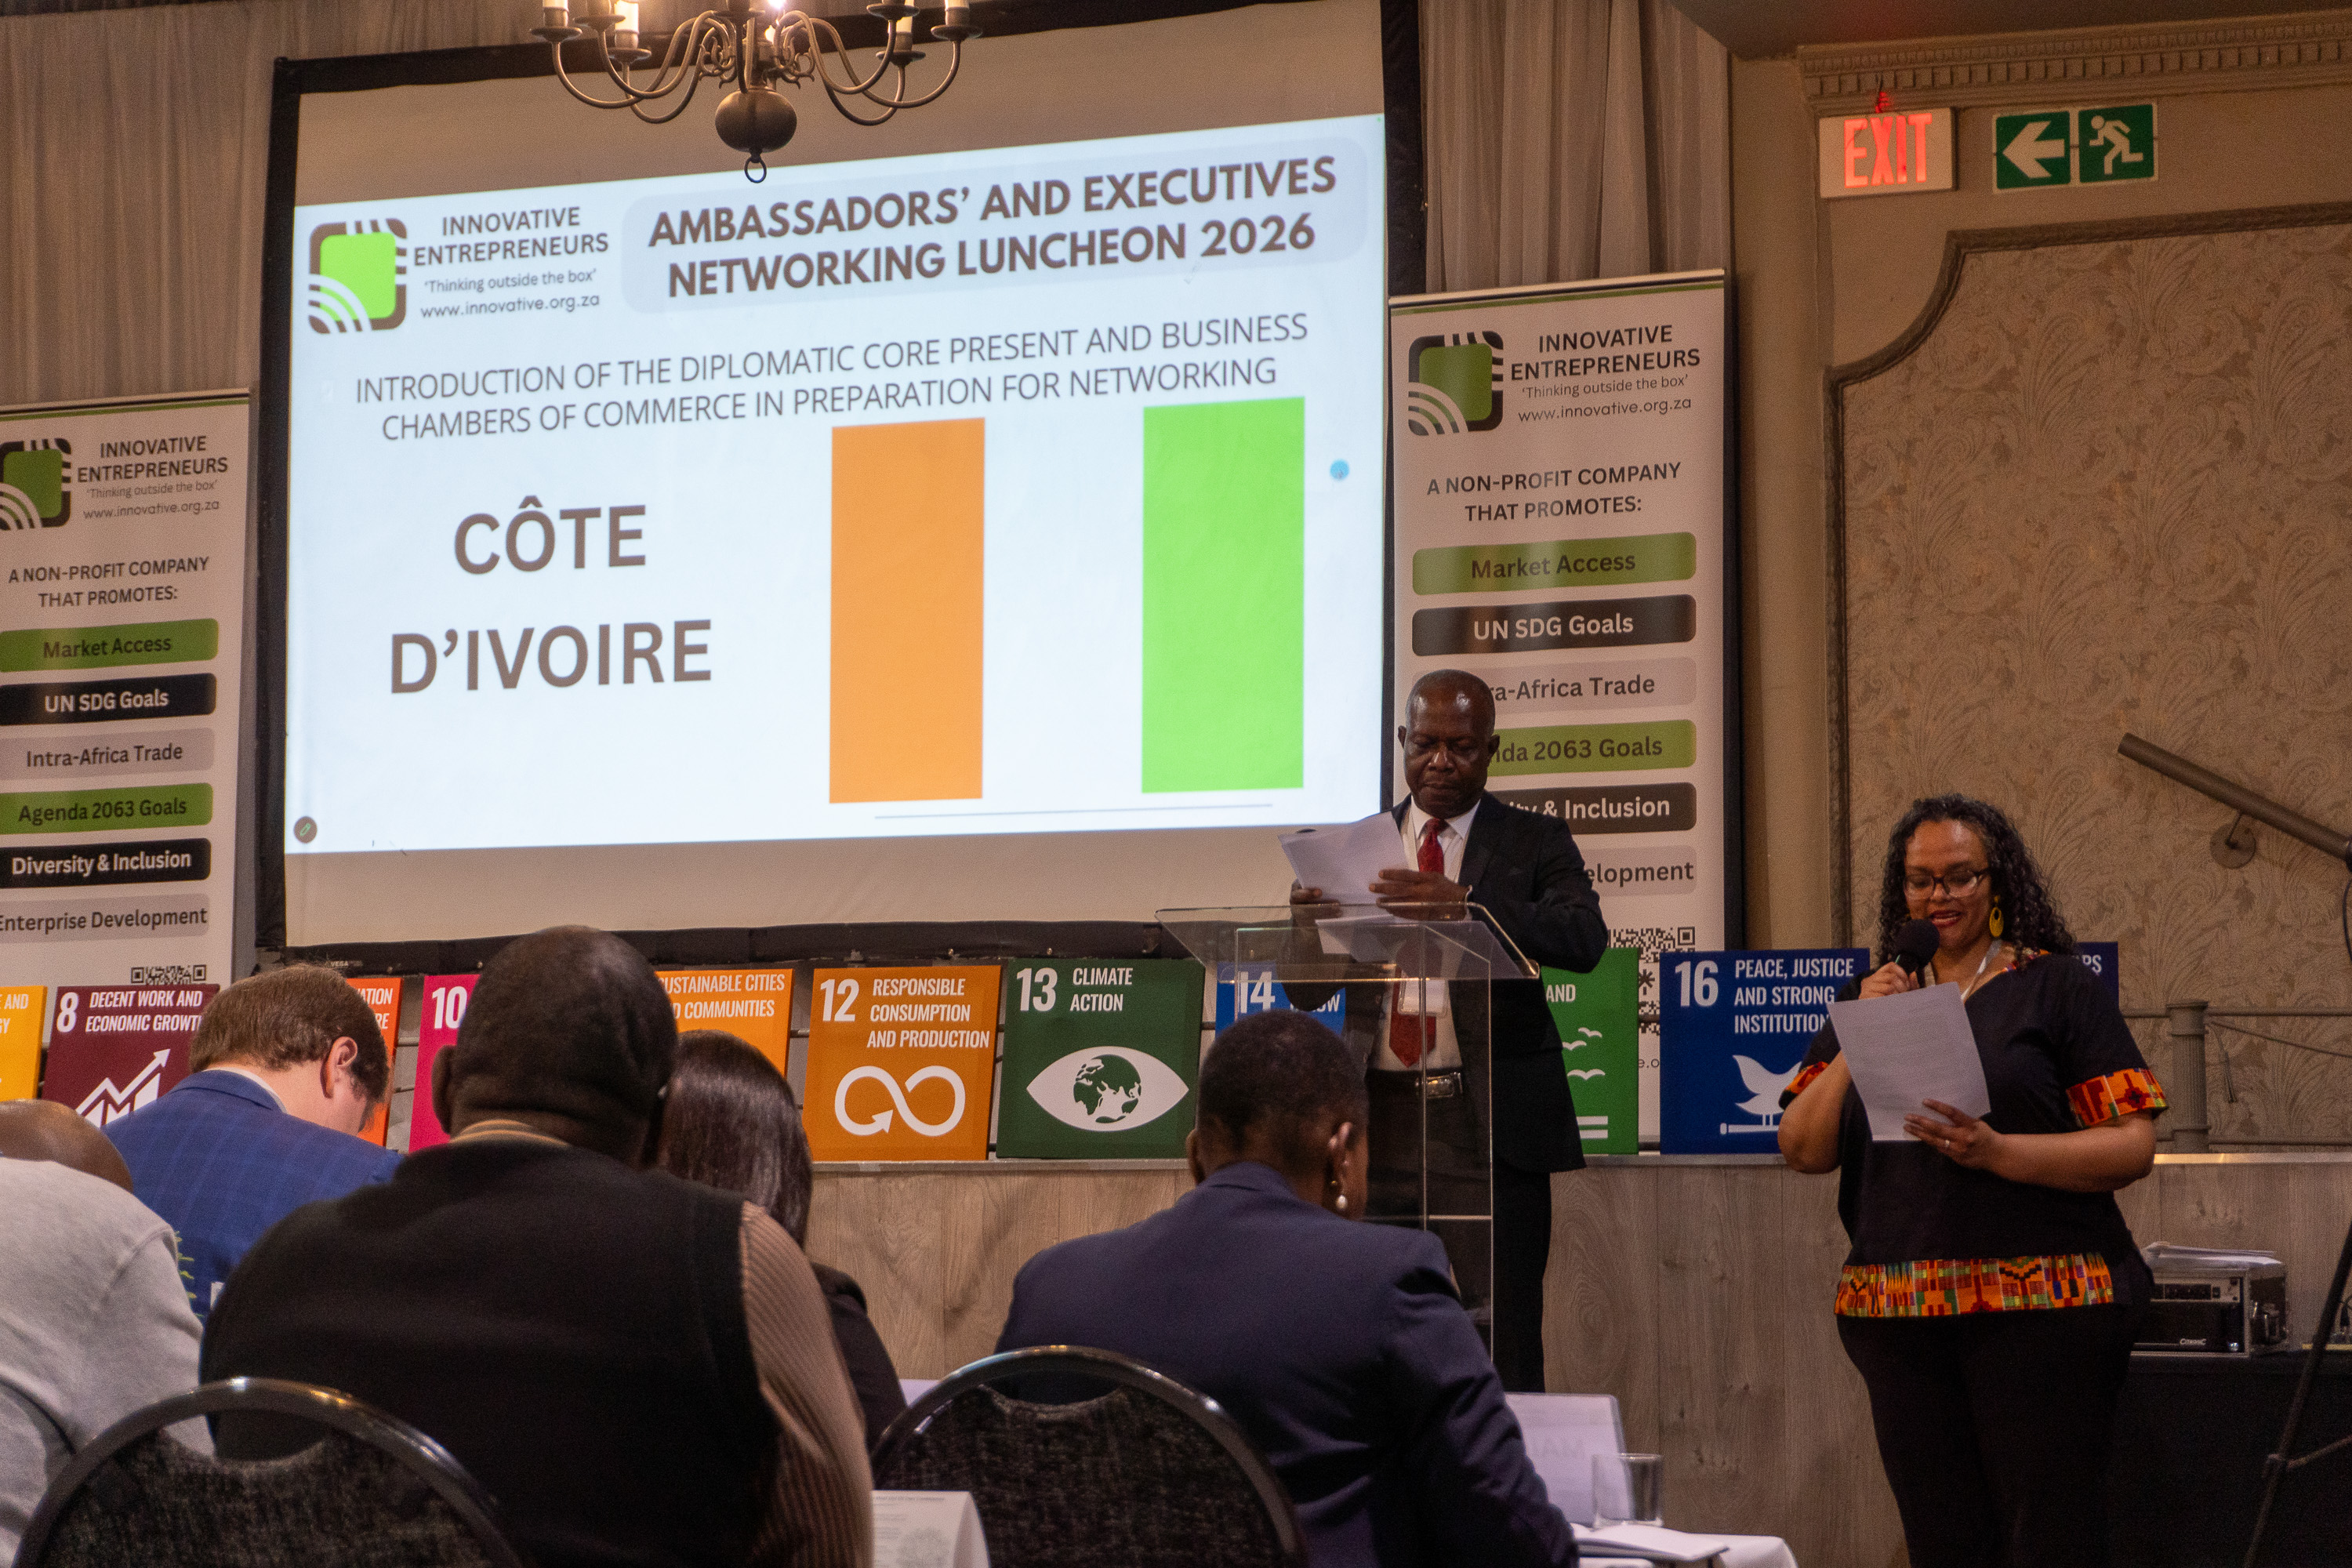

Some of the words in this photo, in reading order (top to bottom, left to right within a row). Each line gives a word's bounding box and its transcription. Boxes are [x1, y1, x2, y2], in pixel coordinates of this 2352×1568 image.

[1844, 113, 1933, 188] EXIT
[648, 186, 971, 247] AMBASSADORS’
[980, 179, 1070, 220] AND
[1083, 155, 1336, 212] EXECUTIVES
[441, 207, 581, 236] INNOVATIVE
[413, 233, 609, 267] ENTREPRENEURS
[669, 244, 946, 297] NETWORKING
[958, 223, 1185, 275] LUNCHEON
[1200, 212, 1315, 257] 2026
[488, 273, 539, 290] outside
[543, 270, 564, 286] the
[420, 293, 600, 318] www.innovative.org.za
[1538, 325, 1672, 353] INNOVATIVE
[357, 364, 564, 403] INTRODUCTION
[574, 361, 610, 388] OF
[618, 357, 671, 384] THE
[681, 347, 855, 382] DIPLOMATIC
[863, 339, 940, 371] CORE
[949, 329, 1079, 364] PRESENT
[1085, 325, 1152, 354] AND
[1161, 313, 1308, 350] BUSINESS
[1511, 348, 1700, 381] ENTREPRENEURS
[1583, 380, 1632, 395] outside
[1635, 377, 1657, 391] the
[382, 403, 531, 441] CHAMBERS
[540, 401, 576, 431] OF
[584, 392, 746, 429] COMMERCE
[756, 390, 782, 418] IN
[794, 377, 992, 415] PREPARATION
[1004, 372, 1060, 401] FOR
[1070, 358, 1276, 397] NETWORKING
[1518, 397, 1691, 423] www.innovative.org.za
[100, 435, 207, 459] INNOVATIVE
[78, 457, 228, 483] ENTREPRENEURS
[1427, 478, 1440, 495] A
[1446, 470, 1573, 493] NON-PROFIT
[1577, 462, 1681, 485] COMPANY
[134, 482, 174, 495] outside
[176, 481, 193, 492] the
[83, 499, 220, 519] www.innovative.org.za
[1465, 503, 1519, 521] THAT
[1524, 495, 1642, 520] PROMOTES:
[454, 495, 646, 575] CÔTE
[9, 569, 20, 583] A
[23, 562, 125, 583] NON-PROFIT
[129, 556, 209, 576] COMPANY
[1472, 555, 1551, 579] Market
[1556, 553, 1636, 574] Access
[38, 592, 83, 608] THAT
[87, 586, 178, 605] PROMOTES:
[1473, 620, 1508, 641] UN
[1515, 617, 1562, 638] SDG
[1568, 612, 1634, 635] Goals
[43, 639, 107, 659] Market
[111, 637, 172, 655] Access
[391, 619, 712, 694] D’IVOIRE
[1589, 674, 1654, 696] Trade
[45, 695, 74, 713] UN
[79, 691, 117, 712] SDG
[120, 688, 169, 709] Goals
[26, 746, 129, 768] Intra-Africa
[134, 742, 183, 762] Trade
[1534, 739, 1592, 760] 2063
[1599, 735, 1662, 758] Goals
[18, 803, 88, 826] Agenda
[92, 800, 135, 819] 2063
[139, 797, 187, 817] Goals
[1566, 797, 1670, 819] Inclusion
[12, 854, 95, 877] Diversity
[97, 854, 111, 871] &
[113, 850, 191, 871] Inclusion
[91, 907, 208, 931] Development
[1072, 967, 1133, 985] CLIMATE
[1734, 959, 1788, 980] PEACE,
[1792, 958, 1854, 977] JUSTICE
[745, 974, 785, 991] CITIES
[873, 978, 966, 996] RESPONSIBLE
[1016, 967, 1058, 1012] 13
[1238, 971, 1276, 1013] 14
[1675, 960, 1719, 1007] 16
[1734, 987, 1767, 1006] AND
[1772, 985, 1835, 1004] STRONG
[4, 994, 29, 1010] AND
[89, 991, 136, 1007] DECENT
[138, 991, 174, 1007] WORK
[176, 991, 203, 1007] AND
[432, 986, 467, 1029] 10
[684, 1000, 775, 1019] COMMUNITIES
[820, 978, 859, 1022] 12
[1069, 993, 1123, 1011] ACTION
[56, 993, 78, 1033] 8
[85, 1015, 151, 1032] ECONOMIC
[870, 1004, 971, 1022] CONSUMPTION
[1734, 1014, 1830, 1033] INSTITUTION
[867, 1030, 895, 1048] AND
[900, 1030, 989, 1048] PRODUCTION
